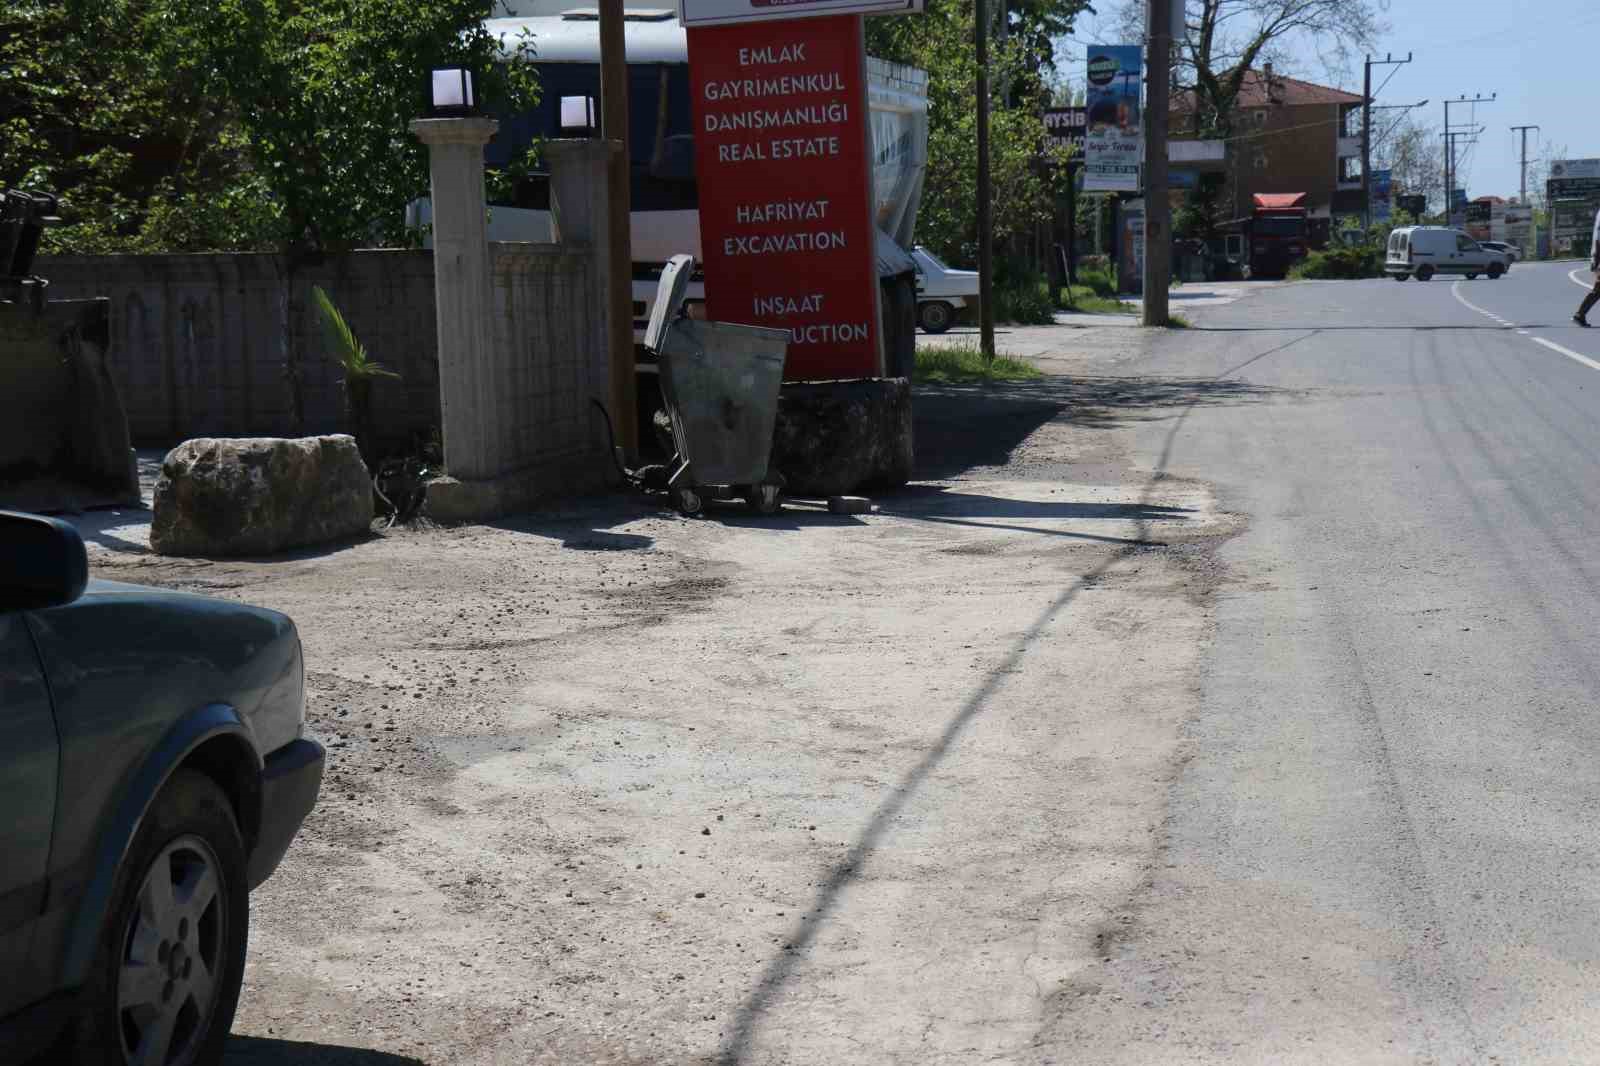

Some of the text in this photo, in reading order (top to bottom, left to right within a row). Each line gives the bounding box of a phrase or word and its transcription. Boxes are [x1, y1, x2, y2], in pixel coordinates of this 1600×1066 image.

[739, 43, 806, 65] EMLAK
[704, 71, 845, 100] GAYRİMENKUL
[719, 136, 839, 162] REAL ESTATE
[736, 198, 829, 223] HAFRİYAT
[724, 231, 846, 256] EXCAVATION
[792, 322, 869, 344] UCTION
